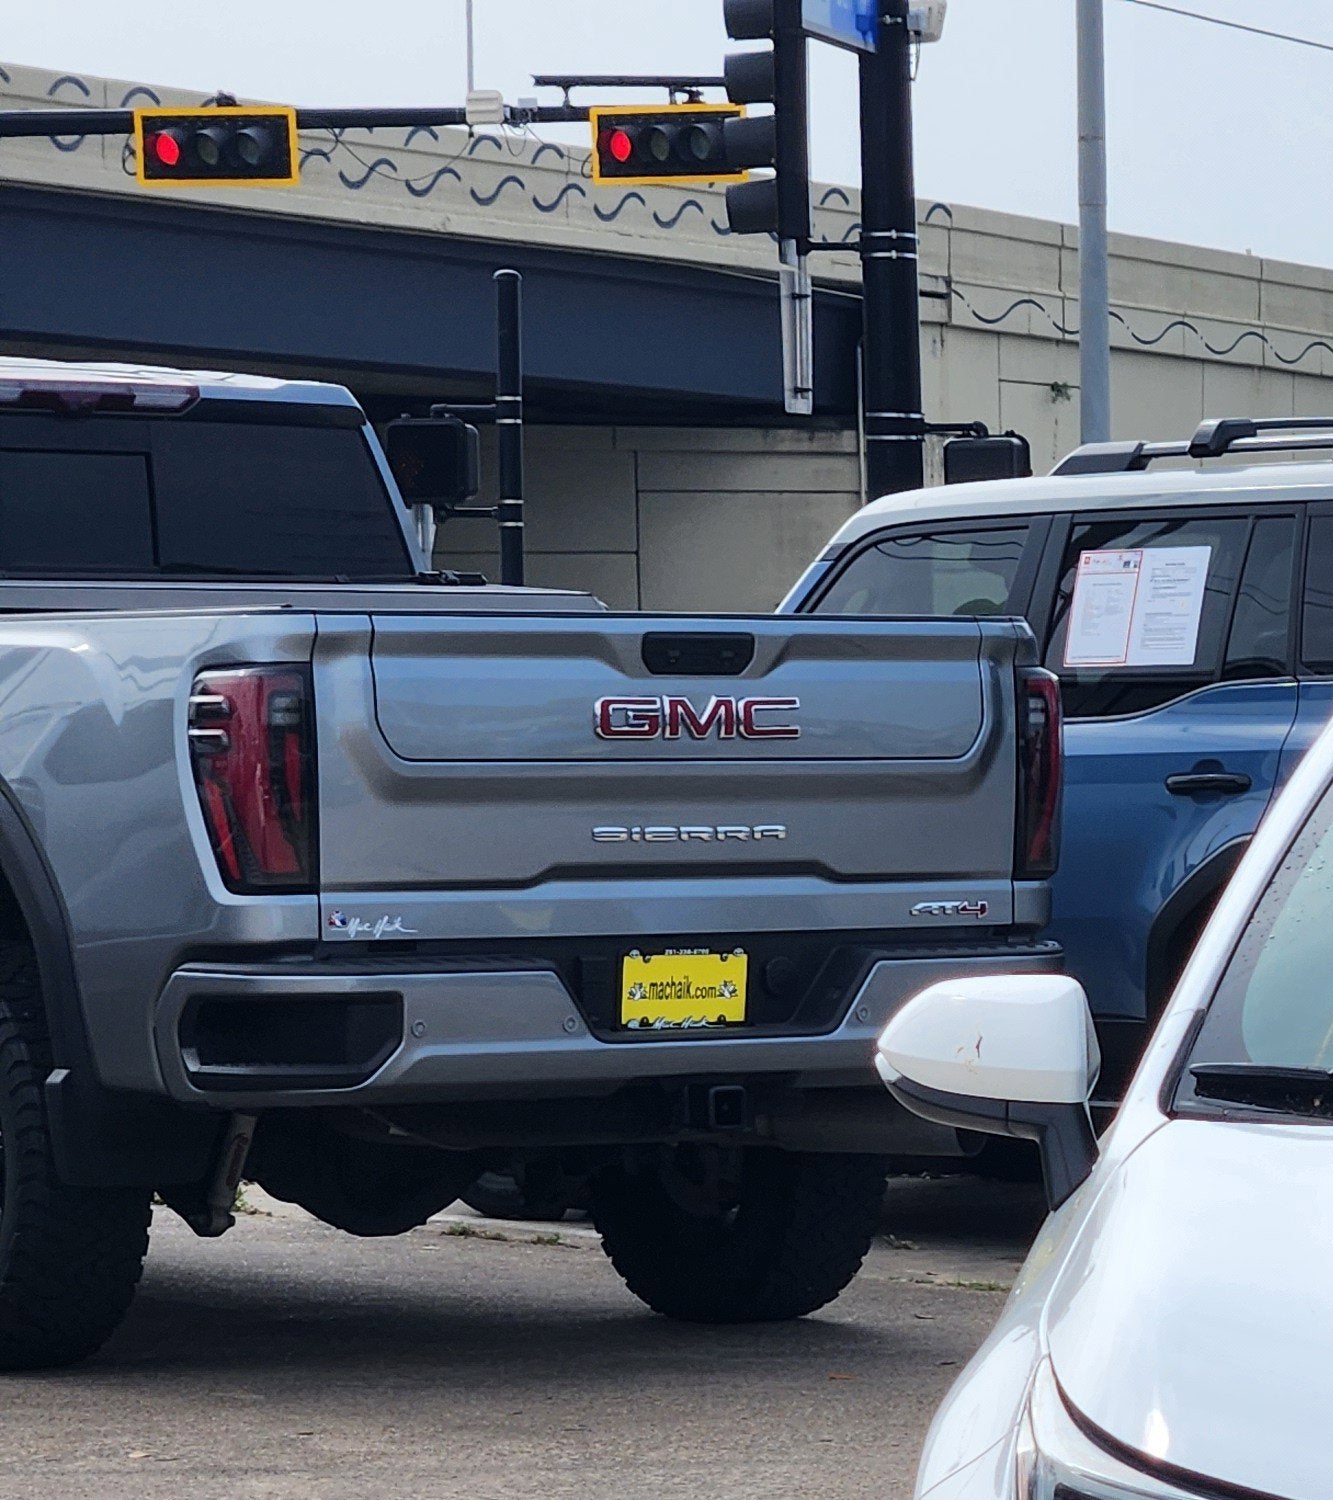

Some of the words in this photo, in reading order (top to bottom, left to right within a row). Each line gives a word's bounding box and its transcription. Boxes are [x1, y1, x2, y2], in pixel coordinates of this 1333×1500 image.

[594, 695, 800, 740] GMC
[592, 825, 787, 842] SIERRA
[910, 901, 988, 918] AT4
[649, 976, 717, 1000] machaik.com
